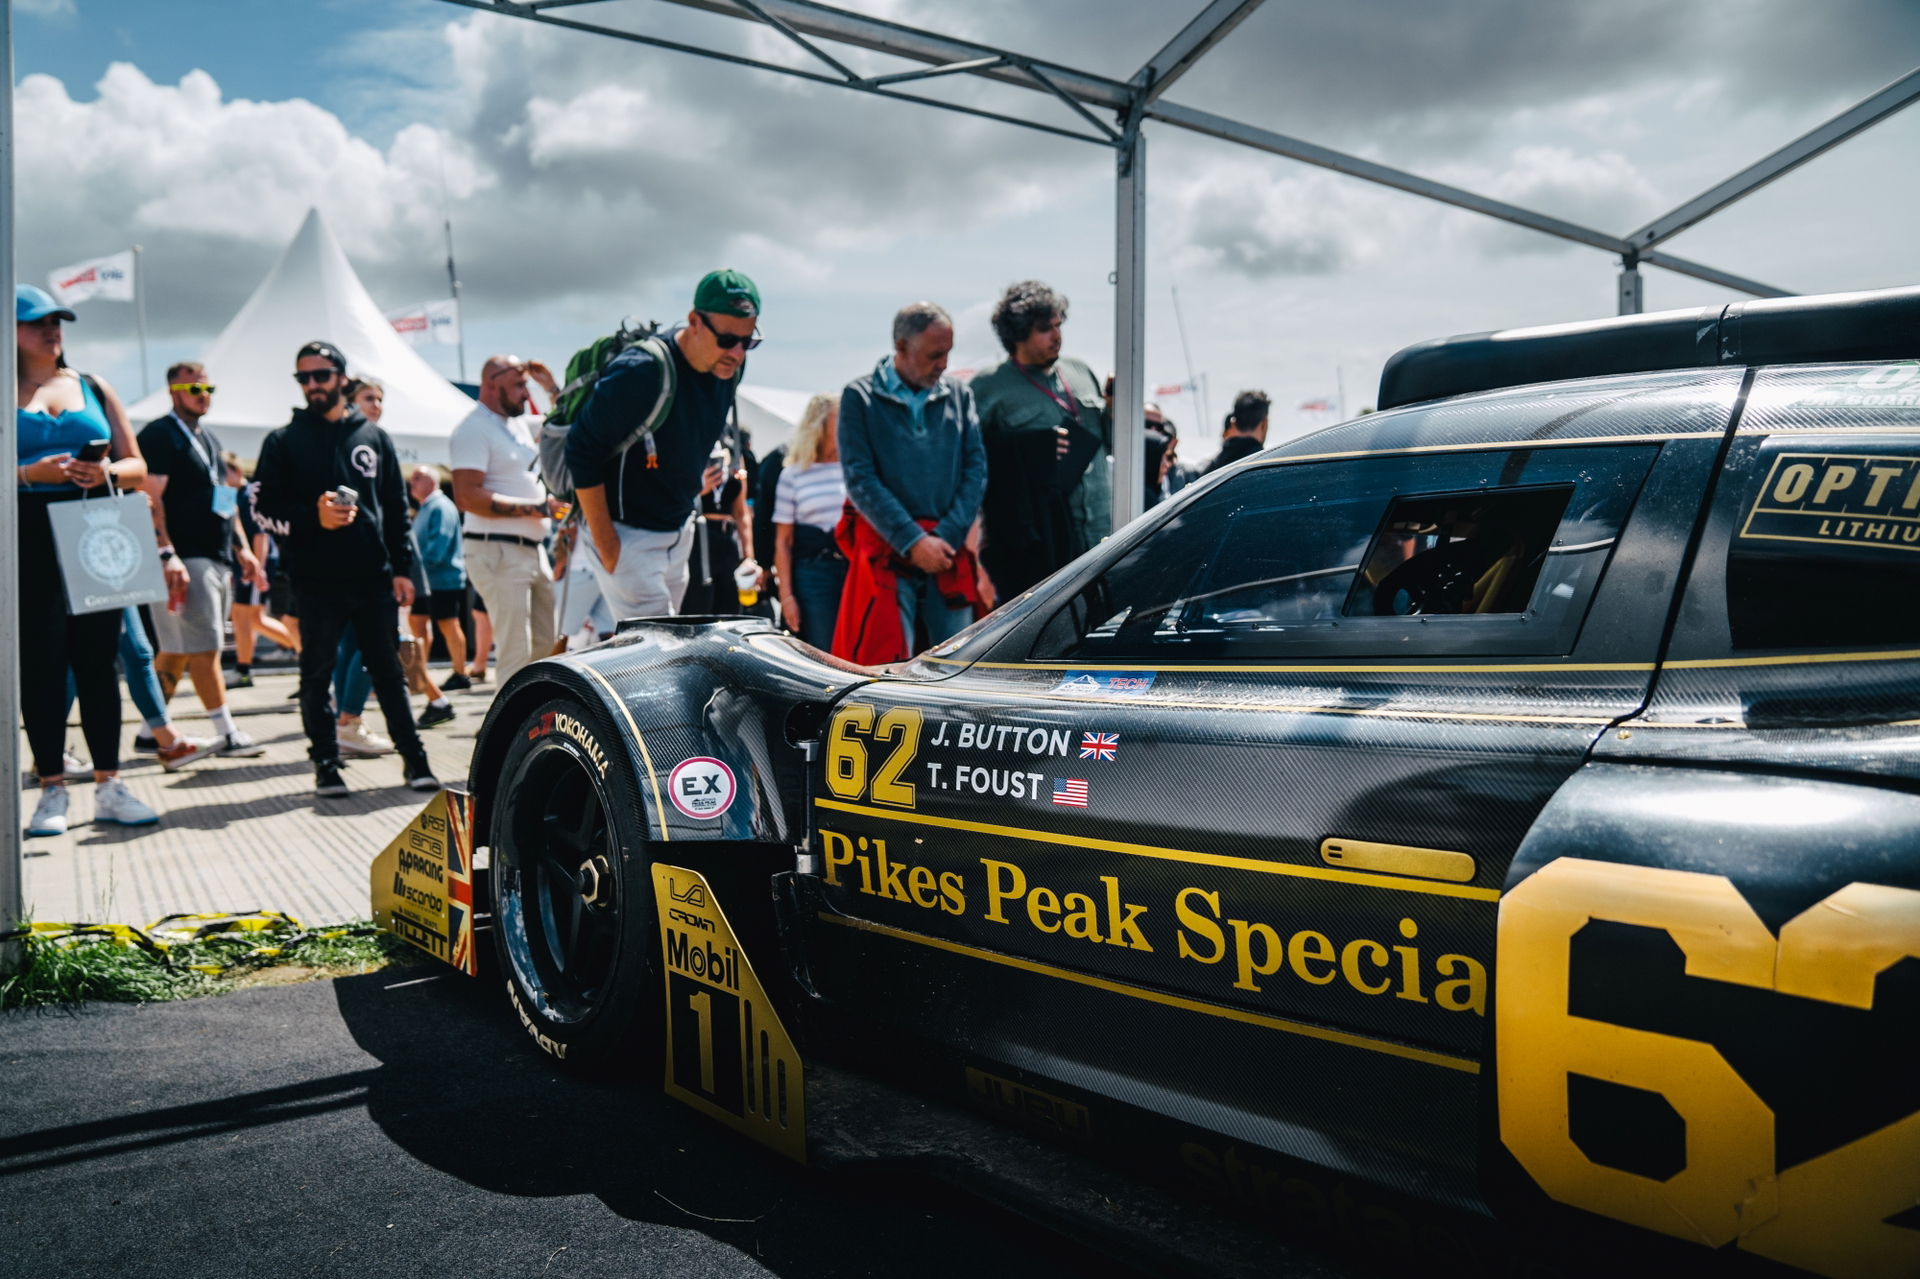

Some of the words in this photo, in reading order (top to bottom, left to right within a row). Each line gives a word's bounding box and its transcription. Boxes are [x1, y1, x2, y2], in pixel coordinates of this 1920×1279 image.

[1844, 394, 1920, 406] BOAR
[1107, 677, 1149, 690] TECH
[555, 713, 609, 780] YOKOHAMA
[825, 703, 924, 809] 62
[930, 721, 949, 746] J.
[957, 723, 1071, 756] BUTTON
[681, 774, 722, 796] EX
[927, 763, 948, 789] T.
[955, 765, 1044, 800] FOUST
[410, 833, 443, 856] aria
[412, 856, 444, 884] RACING
[818, 829, 966, 916] Pikes
[979, 857, 1154, 953] Peak
[668, 907, 716, 934] CROWN
[666, 927, 740, 992] Mobil
[506, 979, 568, 1059] ADVAN
[688, 990, 715, 1095] 1
